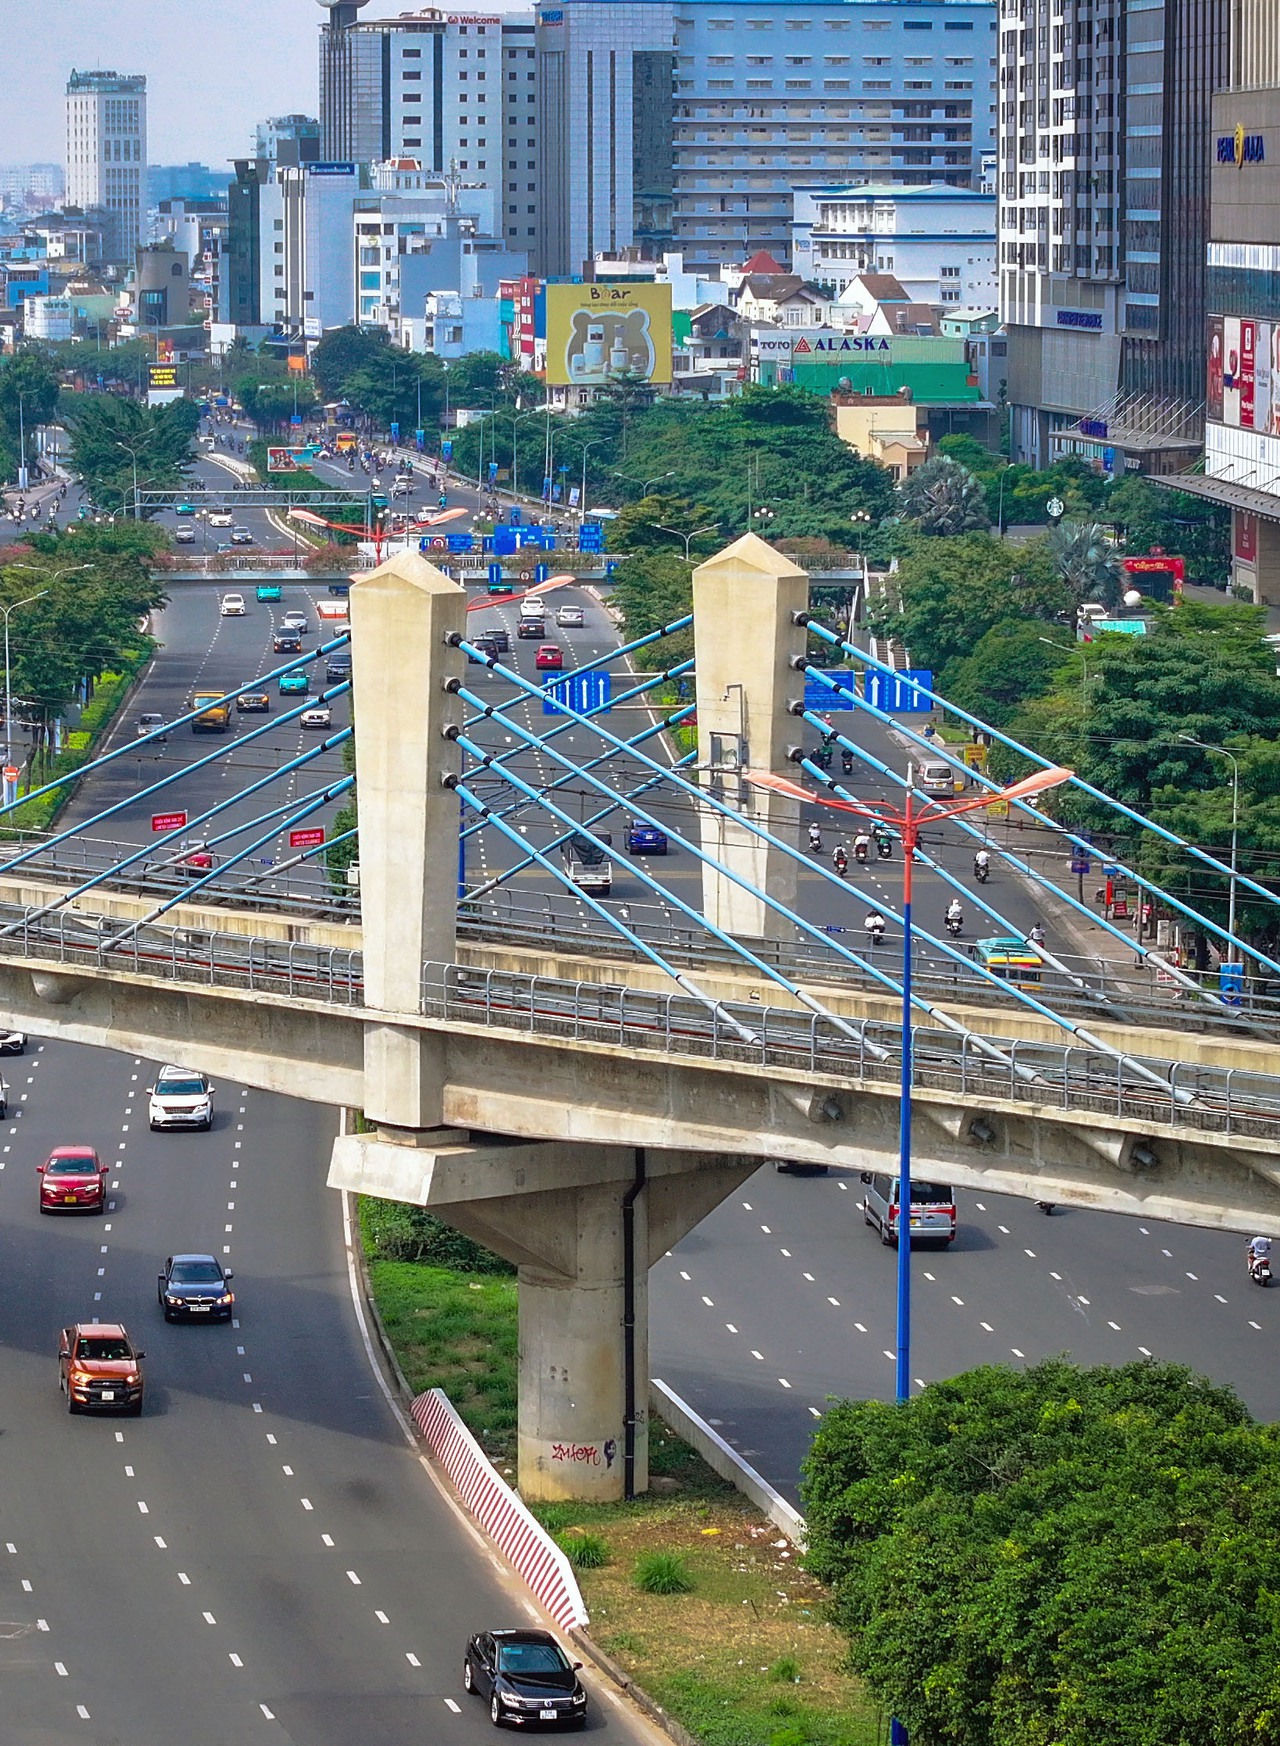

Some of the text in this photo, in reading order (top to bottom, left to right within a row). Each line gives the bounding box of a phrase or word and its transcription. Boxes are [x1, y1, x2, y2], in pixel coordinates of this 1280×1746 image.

[460, 16, 500, 25] Welcome
[310, 165, 351, 173] Sacombank
[760, 341, 790, 350] TOTO
[814, 337, 890, 351] ALASKA
